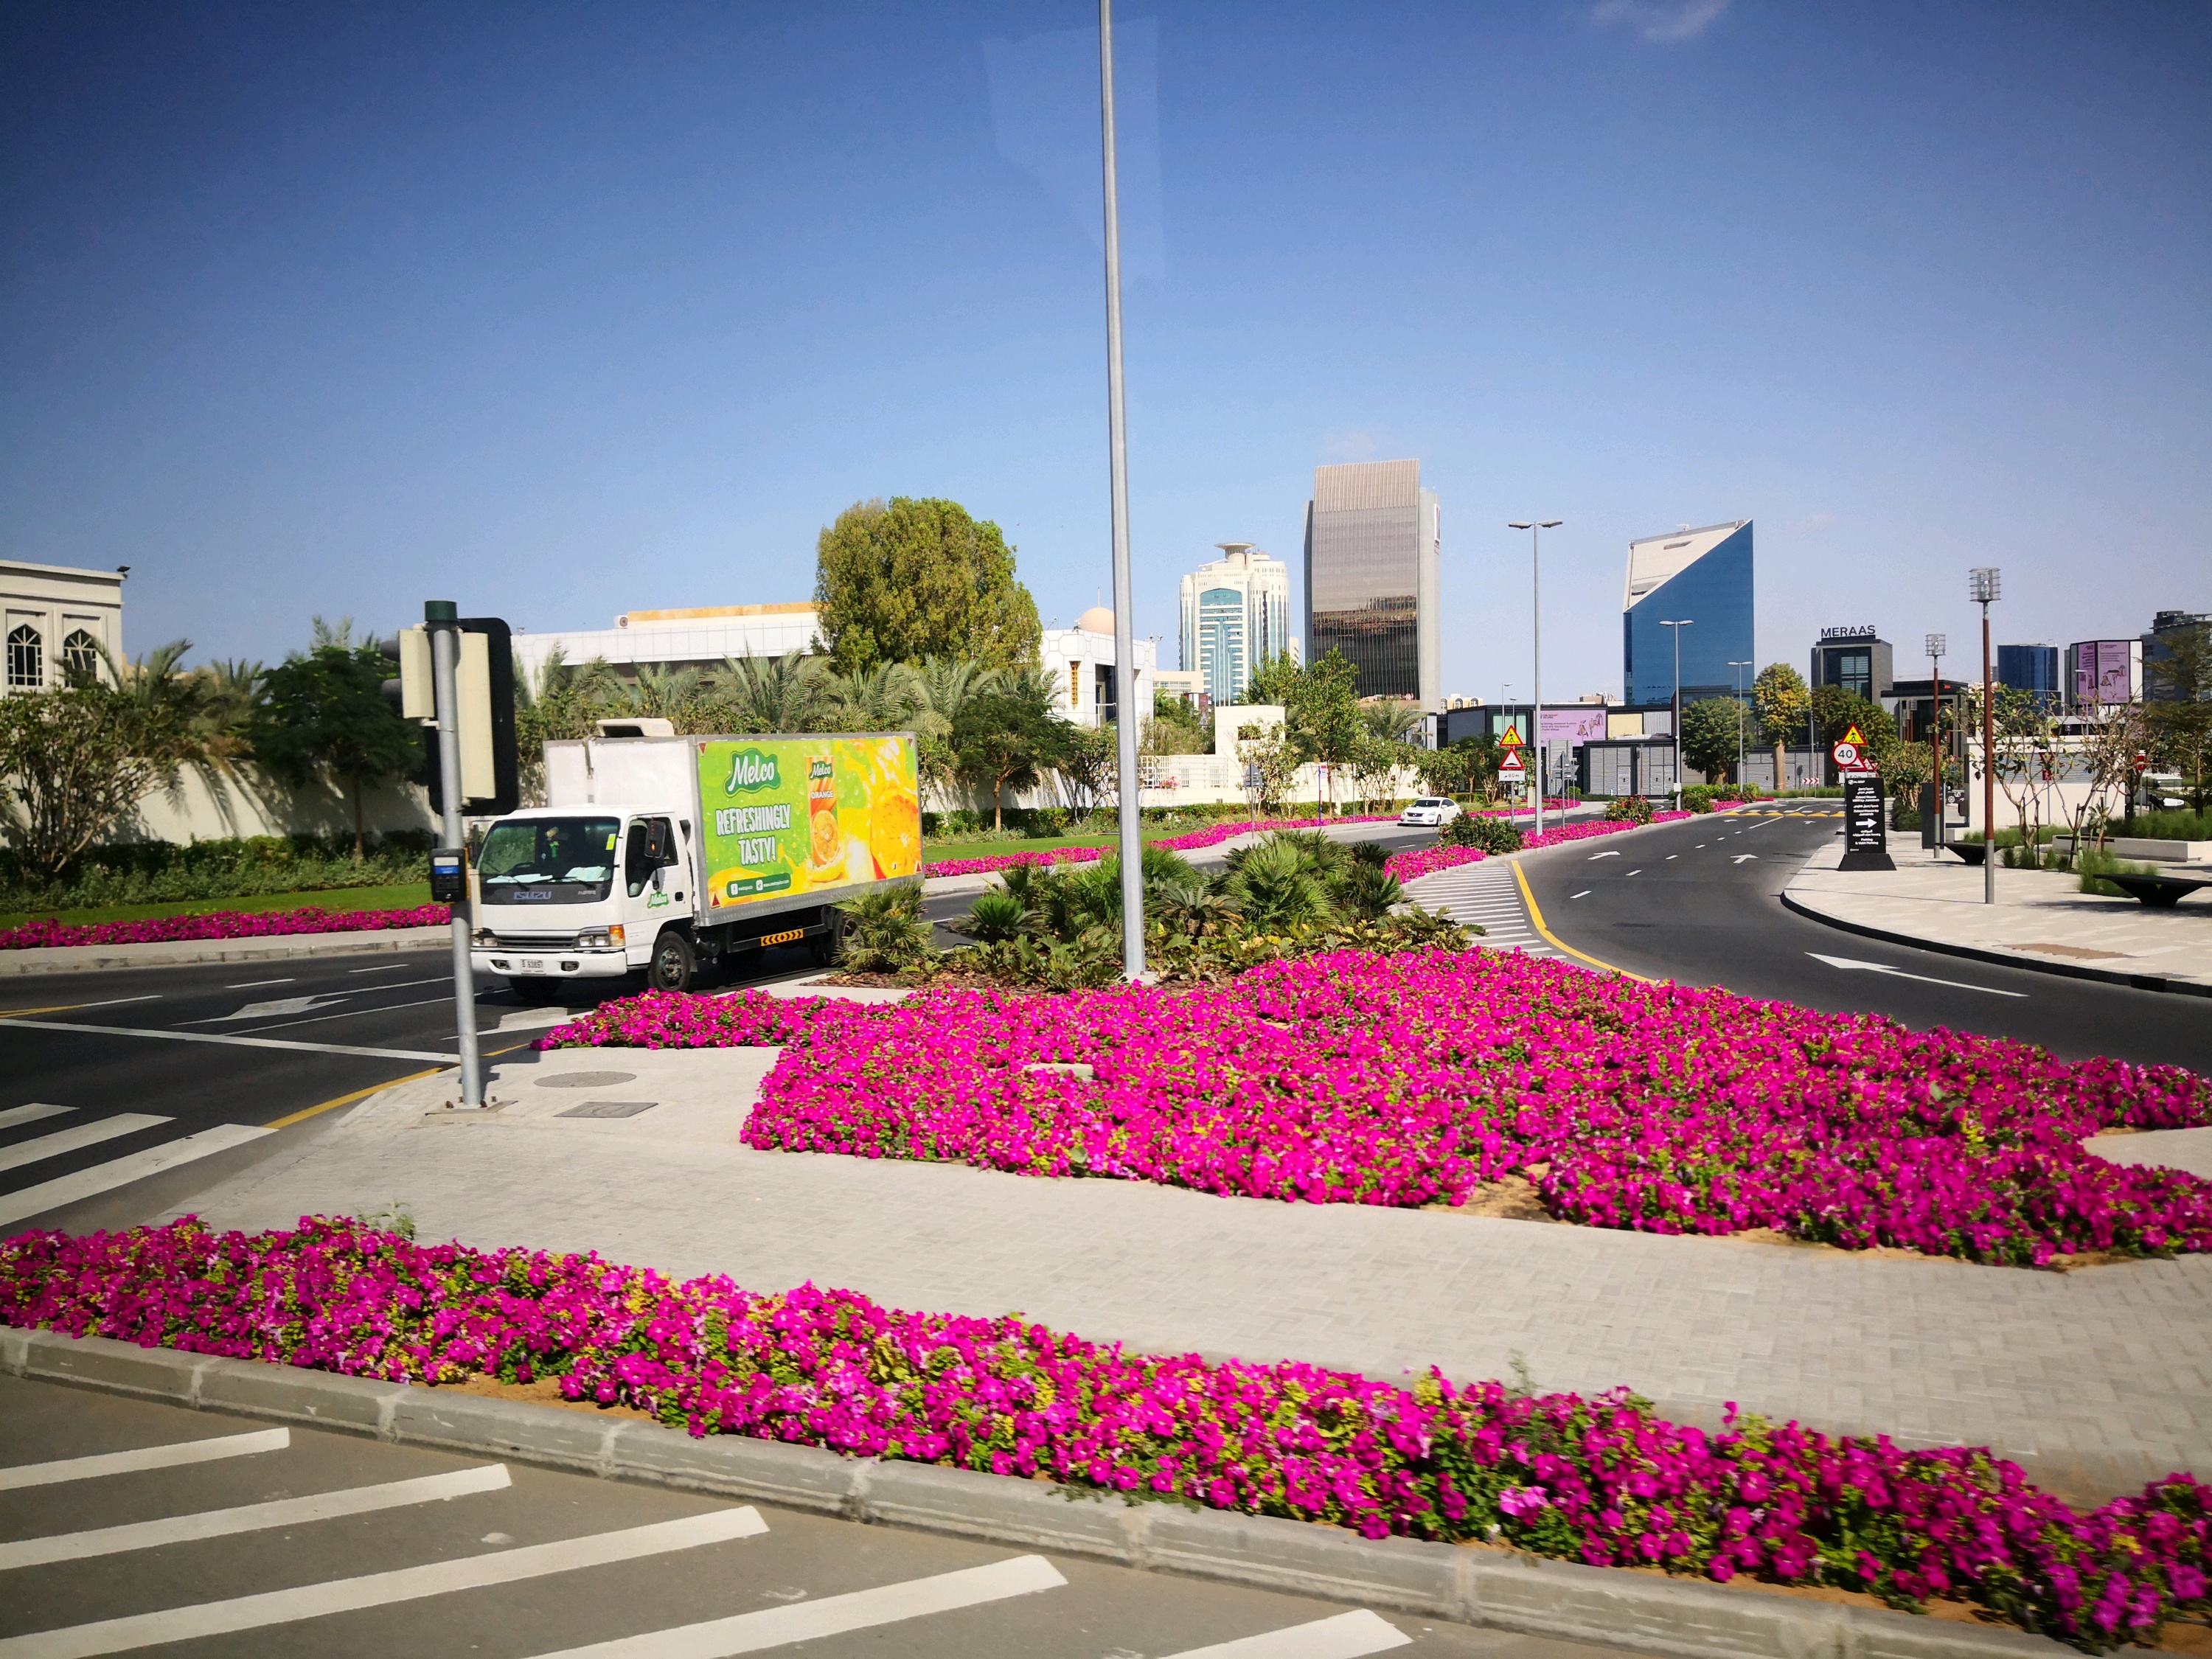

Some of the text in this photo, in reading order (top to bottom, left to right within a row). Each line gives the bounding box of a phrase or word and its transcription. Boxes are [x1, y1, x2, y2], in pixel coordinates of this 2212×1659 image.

[1820, 625, 1876, 638] MERAAS
[1837, 750, 1853, 758] 40
[728, 755, 775, 791] Melco
[810, 764, 831, 779] Melco
[810, 790, 834, 799] ORANGE
[715, 804, 790, 835] REFRESHINGLY
[738, 836, 776, 866] TASTY!
[513, 891, 552, 900] ISUZU
